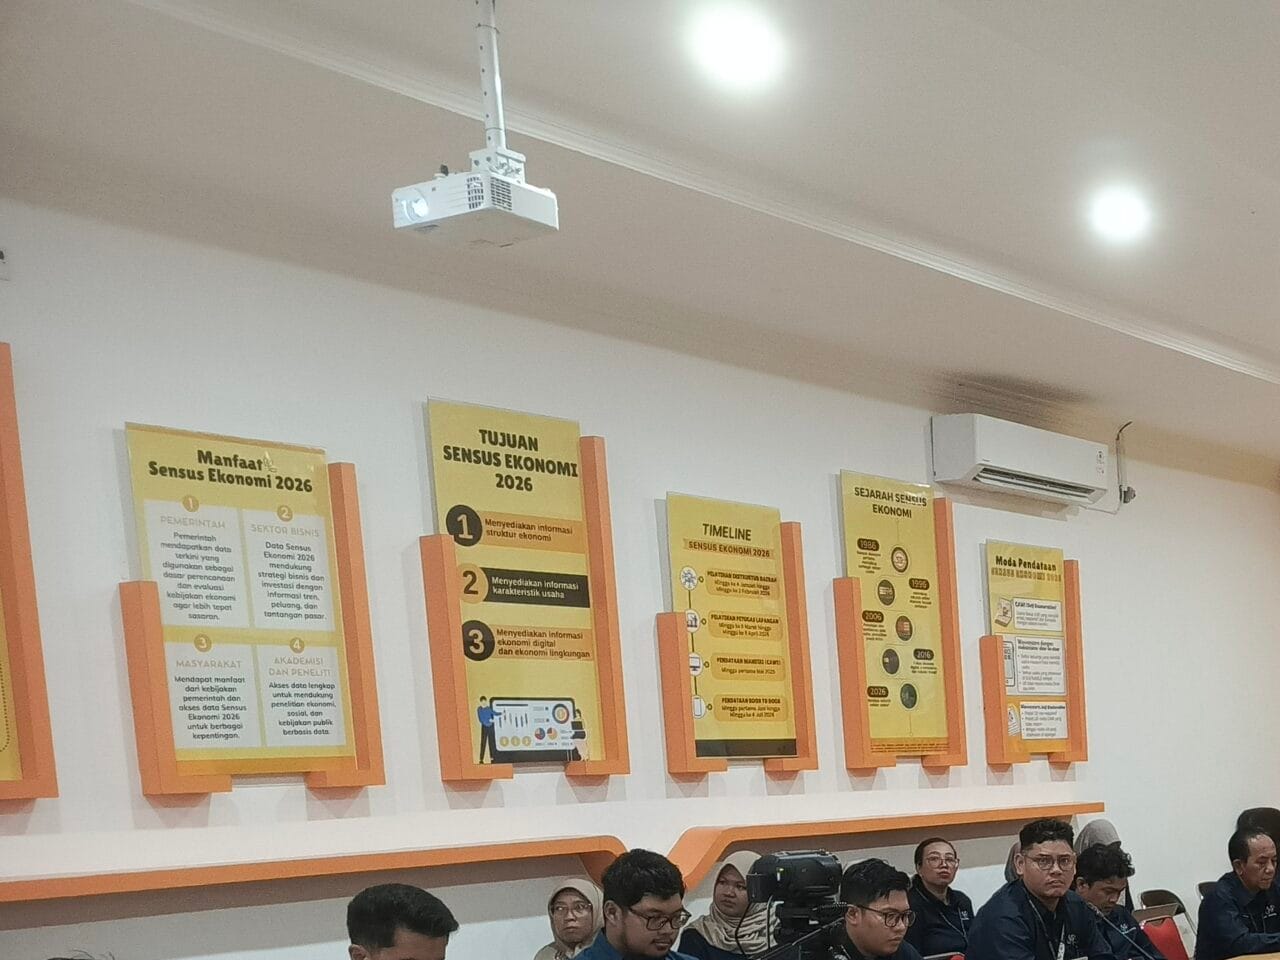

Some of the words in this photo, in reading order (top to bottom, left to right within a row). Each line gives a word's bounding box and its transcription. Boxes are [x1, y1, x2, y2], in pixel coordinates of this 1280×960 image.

[479, 429, 538, 451] TUJUAN
[197, 450, 263, 470] Manfaat
[443, 445, 500, 467] SENSUS
[506, 454, 578, 477] EKONOMI
[148, 461, 204, 481] Sensus
[209, 471, 271, 488] Ekonomi
[276, 476, 312, 492] 2026
[495, 474, 533, 491] 2026
[855, 487, 893, 502] SEJARAH
[895, 494, 927, 507] SENSUS
[187, 498, 194, 509] 1
[281, 508, 289, 519] 2
[872, 504, 911, 518] EKONOMI
[160, 516, 225, 528] PEMERINTAH
[457, 515, 473, 539] 1
[485, 519, 536, 531] Menyediakan
[538, 524, 572, 534] informasi
[251, 524, 288, 535] SEKTOR
[291, 528, 319, 537] BISNIS
[486, 529, 517, 539] struktur
[519, 532, 551, 542] ekonomi
[702, 523, 751, 541] TIMELINE
[174, 532, 216, 542] Pemerintah
[160, 542, 213, 552] mendapatkan
[286, 543, 311, 551] Sensus
[689, 541, 717, 551] SENSUS
[719, 545, 752, 555] EKONOMI
[753, 548, 769, 557] 2026
[200, 555, 219, 563] yang
[264, 552, 295, 560] Ekonomi
[162, 562, 203, 572] digunakan
[269, 562, 311, 572] mendukung
[996, 555, 1016, 567] Moda
[1019, 558, 1056, 571] Pendataan
[258, 572, 286, 581] strategi
[288, 572, 309, 580] bisnis
[462, 571, 478, 594] 2
[492, 577, 542, 588] Menyediakan
[544, 580, 578, 590] informasi
[296, 584, 323, 592] dengan
[493, 587, 540, 597] karakteristik
[542, 590, 565, 599] usaha
[166, 591, 203, 601] kebijakan
[267, 591, 301, 599] informasi
[264, 611, 303, 620] tantangan
[497, 629, 547, 639] Menyediakan
[549, 631, 583, 639] informasi
[199, 638, 207, 649] 3
[292, 640, 301, 650] 4
[468, 630, 484, 653] 3
[497, 639, 531, 647] ekonomi
[532, 640, 556, 648] digital
[498, 648, 513, 656] dan
[515, 648, 548, 656] ekonomi
[550, 649, 590, 658] lingkungan
[176, 660, 242, 669] MASYARAKAT
[274, 657, 323, 665] AKADEMISI
[269, 667, 289, 676] DAN
[292, 668, 331, 676] PENELITI
[175, 676, 212, 684] Mendapat
[203, 685, 236, 693] kebijakan
[309, 682, 335, 691] lengkap
[294, 691, 333, 700] mendukung
[210, 722, 242, 731] berbagai
[279, 719, 311, 727] kebijakan
